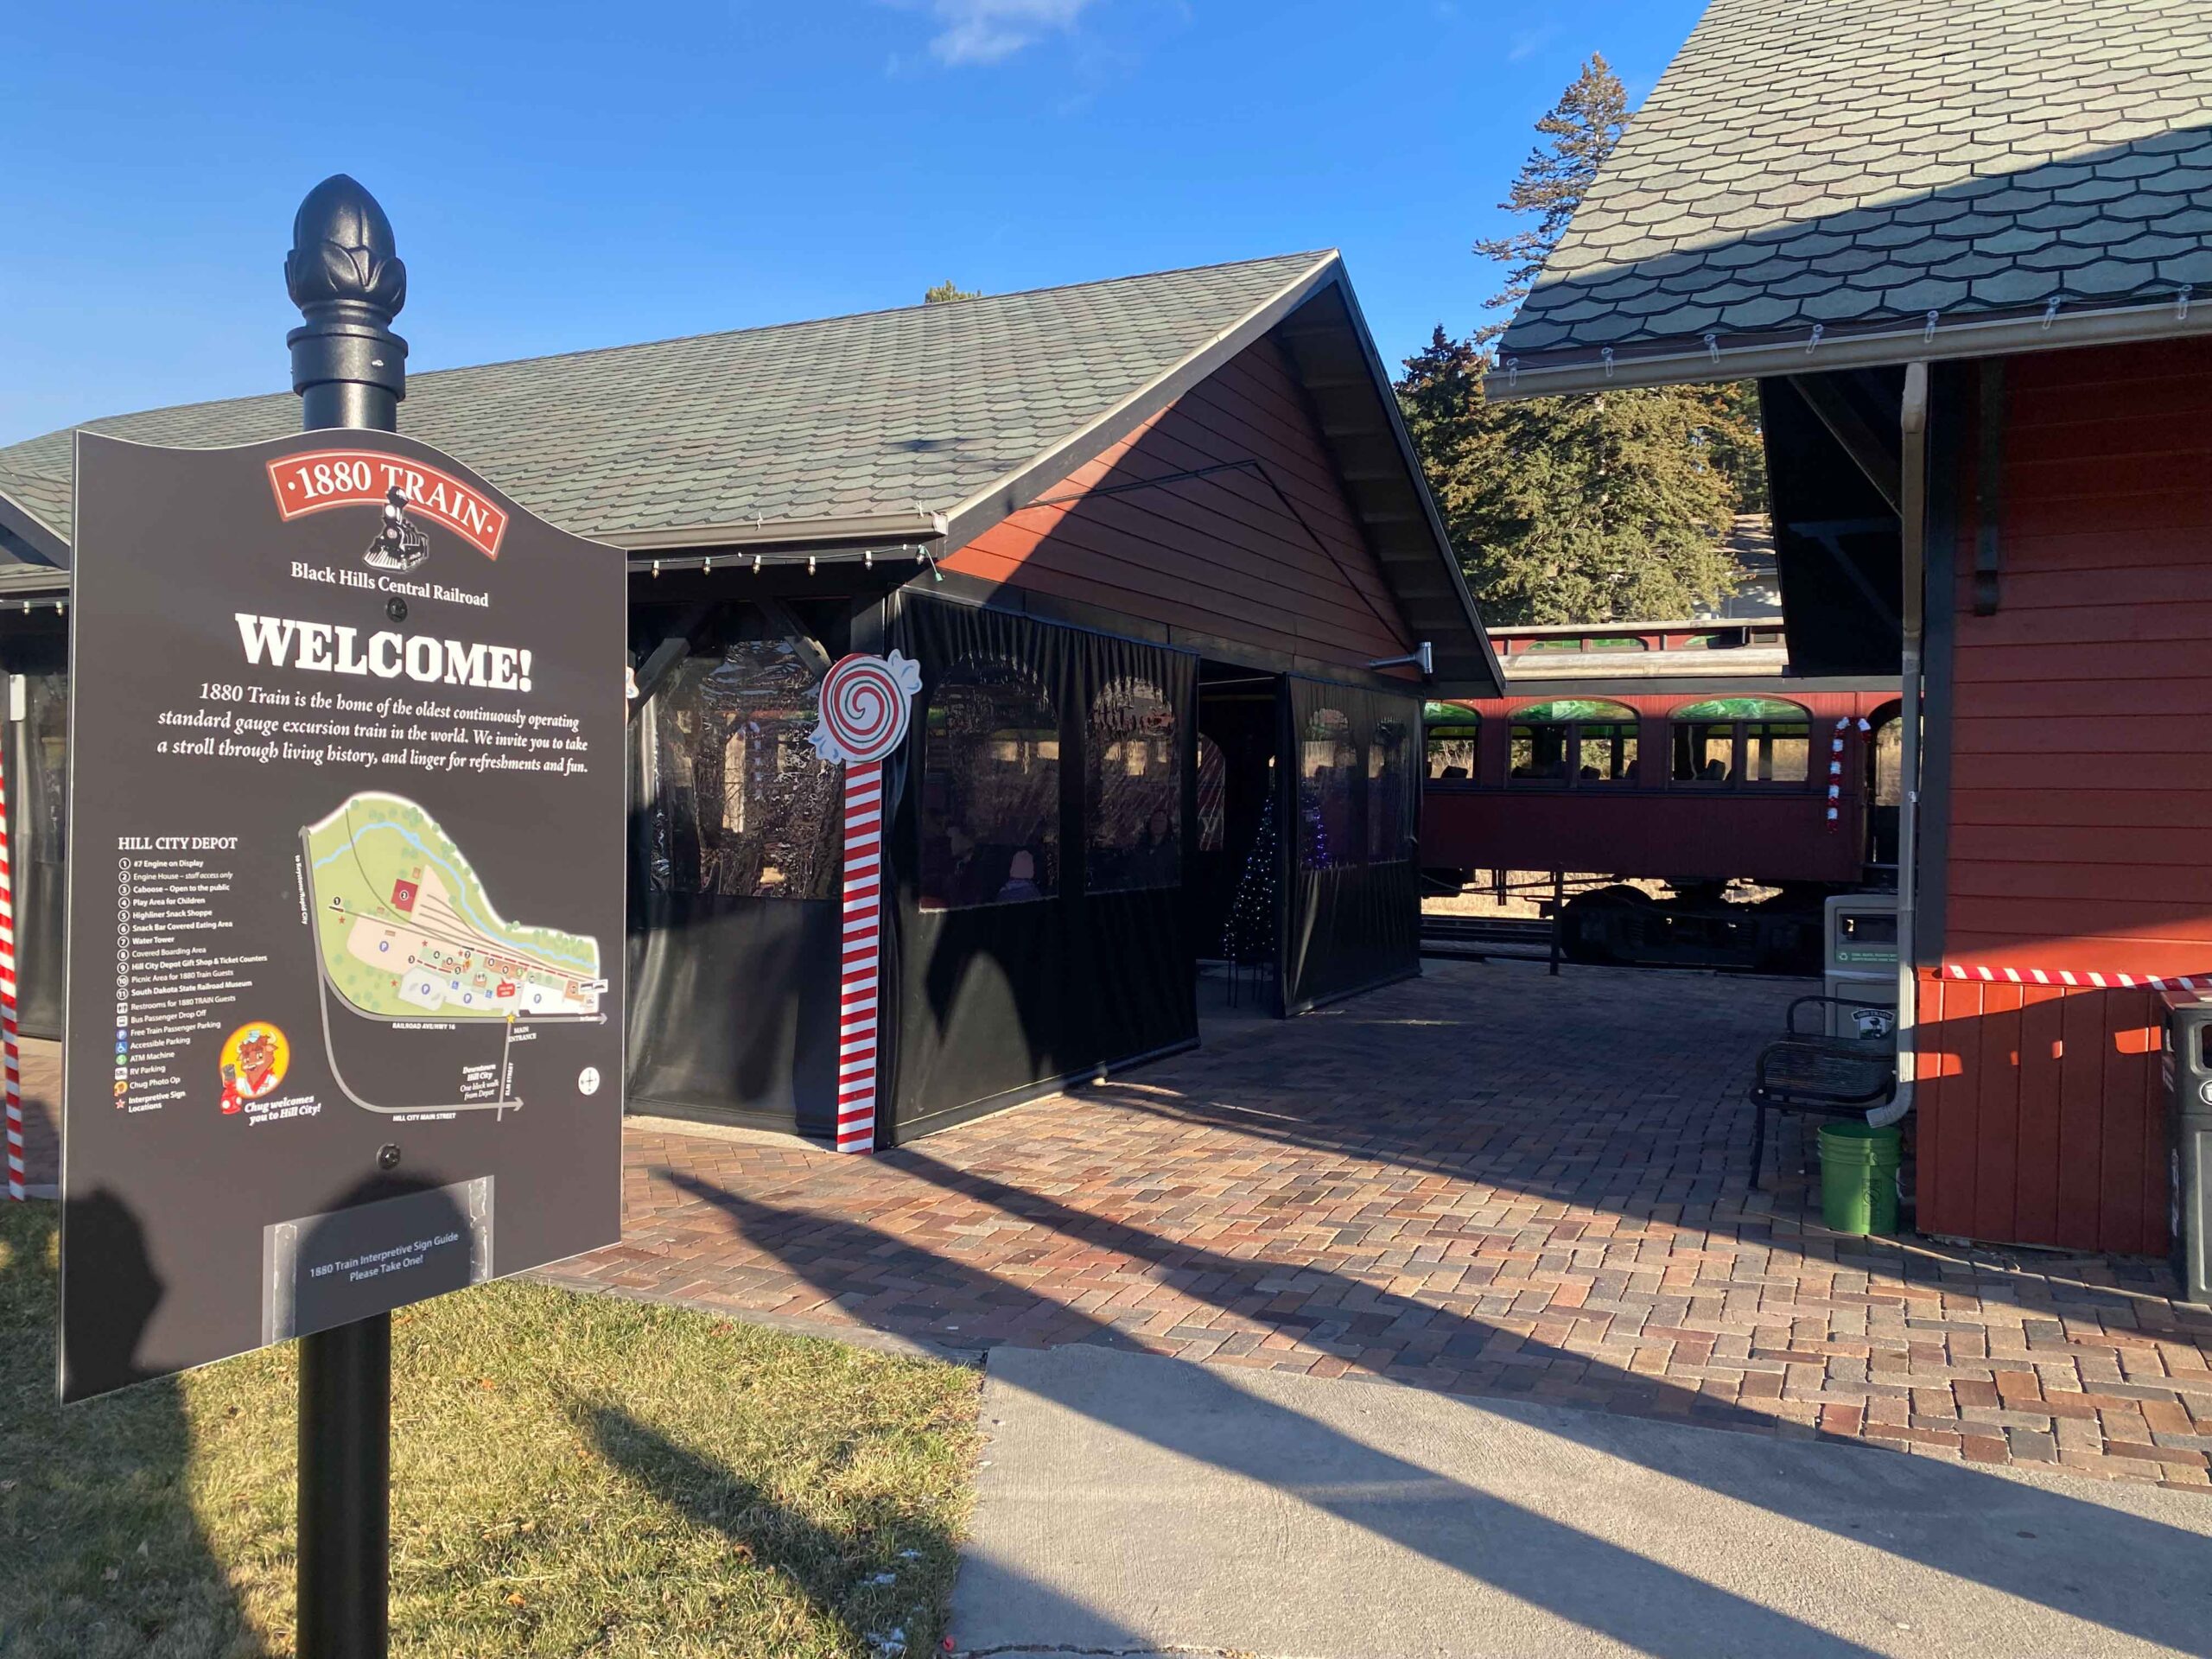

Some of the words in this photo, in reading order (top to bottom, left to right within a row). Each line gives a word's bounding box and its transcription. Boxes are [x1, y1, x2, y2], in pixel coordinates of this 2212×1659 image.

[296, 461, 372, 499] 1880
[380, 463, 490, 535] TRAIN
[291, 562, 335, 584] Black
[340, 569, 375, 589] Hills
[378, 576, 430, 598] Central
[434, 585, 488, 607] Railroad
[234, 613, 531, 692] WELCOME!
[200, 683, 243, 702] 1880
[248, 686, 290, 705] Train
[295, 691, 306, 707] is
[310, 692, 332, 709] the
[337, 694, 372, 712] home
[377, 697, 391, 717] of
[392, 698, 412, 715] the
[416, 701, 450, 718] oldest
[454, 707, 525, 728] continuously
[529, 715, 579, 733] operating
[158, 709, 231, 728] standard
[234, 717, 278, 736] gauge
[283, 720, 349, 735] excursion
[354, 723, 386, 739] train
[391, 724, 404, 740] in
[408, 725, 427, 741] the
[430, 728, 468, 743] world.
[474, 729, 493, 745] We
[496, 733, 527, 747] invite
[530, 739, 550, 752] you
[552, 737, 563, 749] to
[566, 737, 588, 751] take
[172, 738, 214, 755] stroll
[219, 739, 278, 763] through
[283, 742, 323, 766] living
[327, 745, 378, 767] history,
[382, 749, 406, 765] and
[410, 750, 446, 770] linger
[446, 752, 467, 771] for
[470, 753, 541, 772] refreshments
[543, 758, 563, 772] and
[563, 758, 588, 776] fun.
[118, 837, 152, 849] HILL
[156, 837, 190, 849] CITY
[192, 837, 238, 849] DEPOT
[133, 912, 165, 920] Highliner
[160, 960, 181, 969] Depot
[239, 955, 267, 963] Counters
[145, 1014, 177, 1023] Passenger
[164, 1026, 196, 1034] Passenger
[130, 1041, 164, 1050] Accessible
[166, 1038, 190, 1046] Parking
[147, 1052, 175, 1061] Machine
[141, 1065, 166, 1074] Parking
[129, 1095, 169, 1104] Interpretive
[170, 1090, 186, 1101] Sign
[245, 1102, 269, 1114] Chug
[270, 1096, 314, 1109] welcomes
[129, 1103, 162, 1113] Locations
[249, 1115, 267, 1126] you
[280, 1109, 297, 1119] Hill
[299, 1103, 321, 1116] City!
[310, 1264, 333, 1278] 1880
[335, 1259, 358, 1272] Train
[360, 1245, 412, 1266] Interpretive
[414, 1239, 432, 1252] Sign
[434, 1232, 459, 1246] Guide
[350, 1266, 378, 1281] Please
[381, 1260, 401, 1274] Take
[403, 1255, 423, 1267] One!
